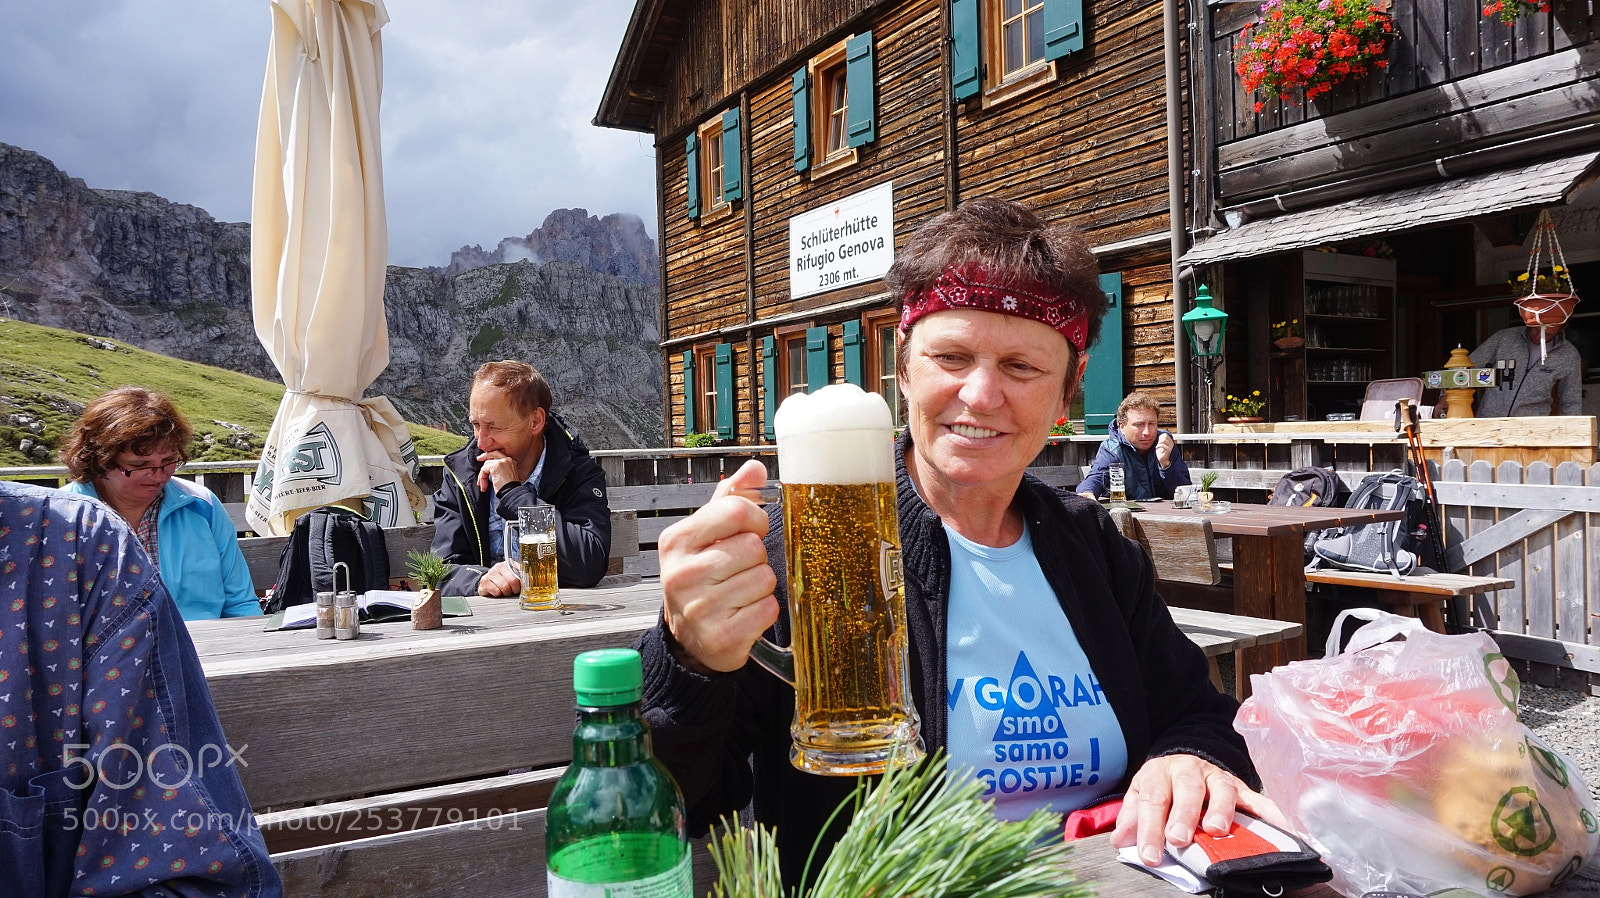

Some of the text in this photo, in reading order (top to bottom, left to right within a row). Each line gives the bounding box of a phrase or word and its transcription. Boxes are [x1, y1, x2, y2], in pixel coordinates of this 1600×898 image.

[801, 215, 878, 250] Schlüterhütte
[796, 237, 884, 272] Rifugio Genova
[819, 267, 859, 287] 2306 mt.
[1003, 715, 1059, 735] smo
[994, 741, 1069, 763] samo
